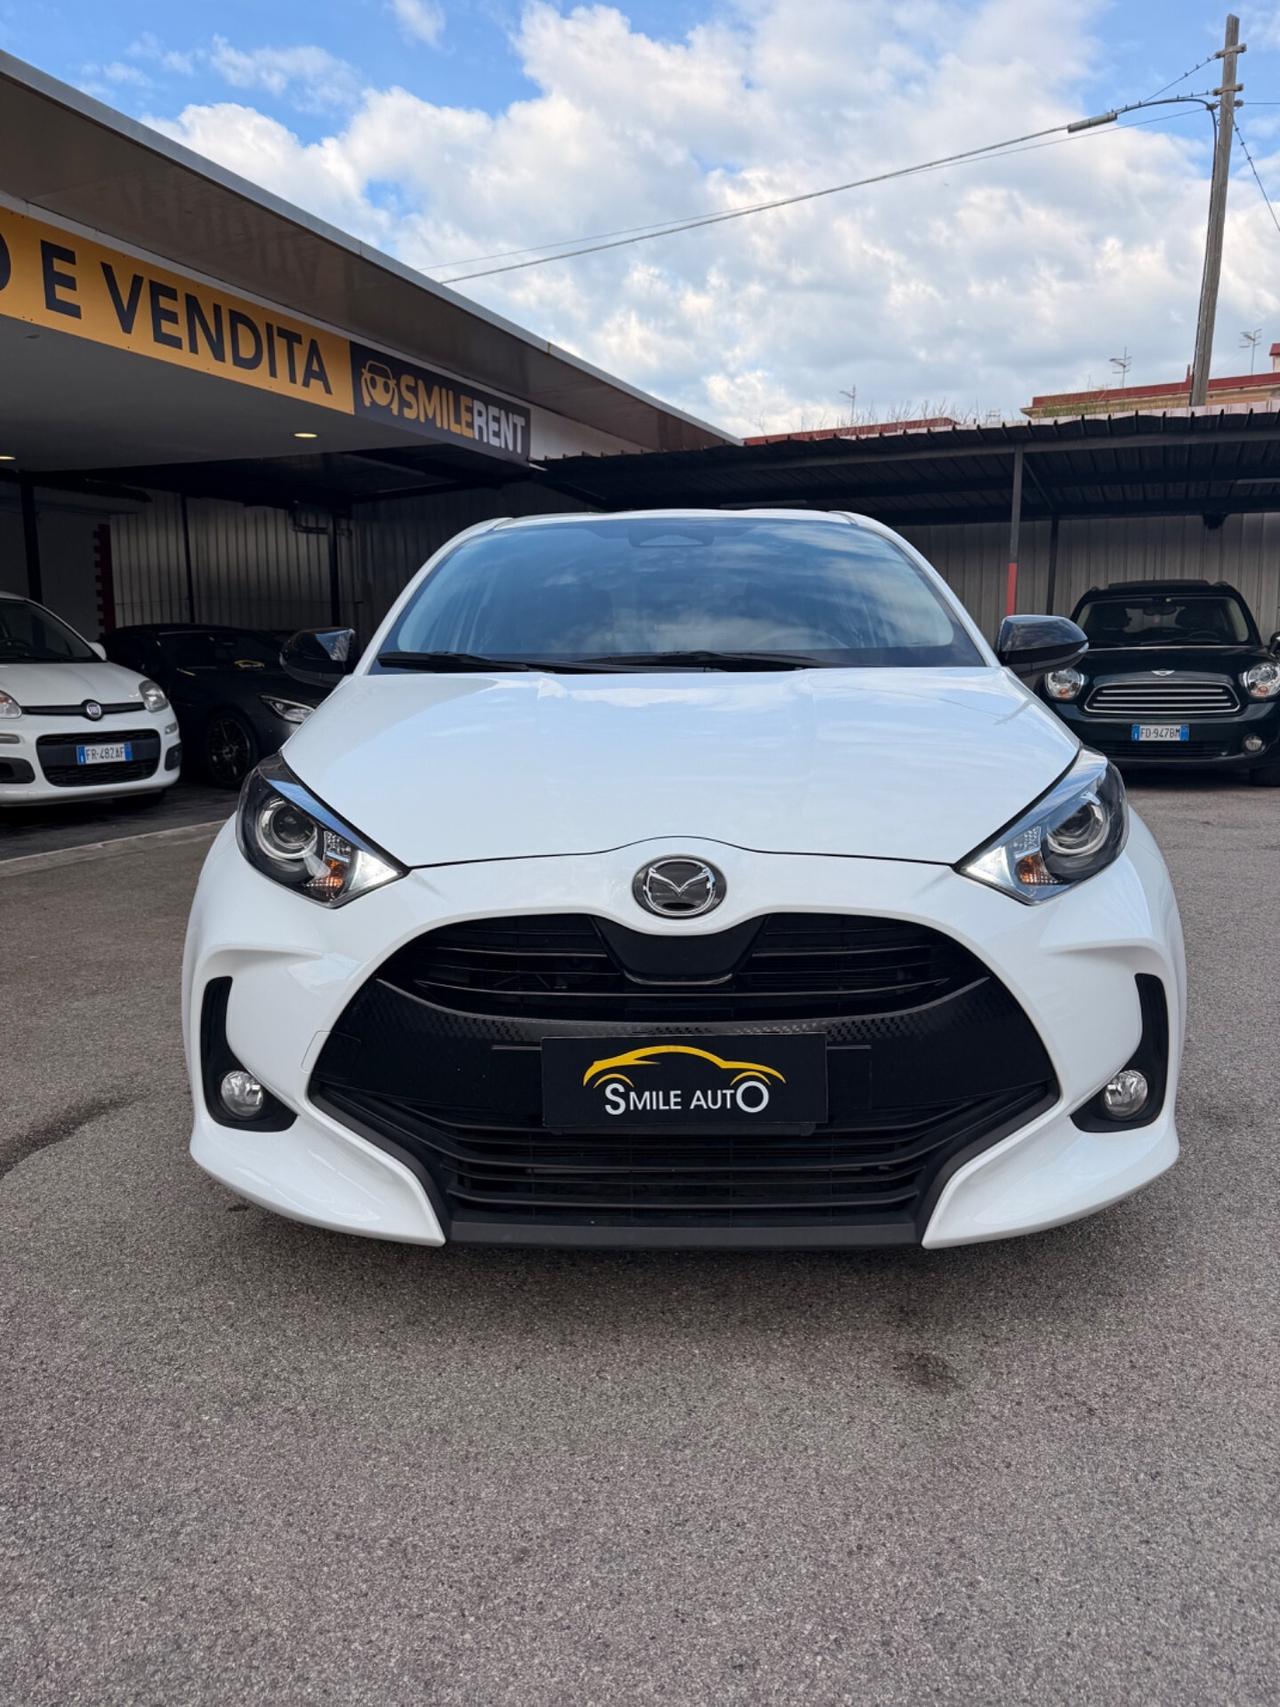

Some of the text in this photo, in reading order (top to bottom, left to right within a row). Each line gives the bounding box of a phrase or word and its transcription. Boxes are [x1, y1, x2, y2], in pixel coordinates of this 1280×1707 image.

[40, 239, 82, 320] E
[100, 261, 333, 396] VENDITA
[400, 374, 526, 455] SMILERENT
